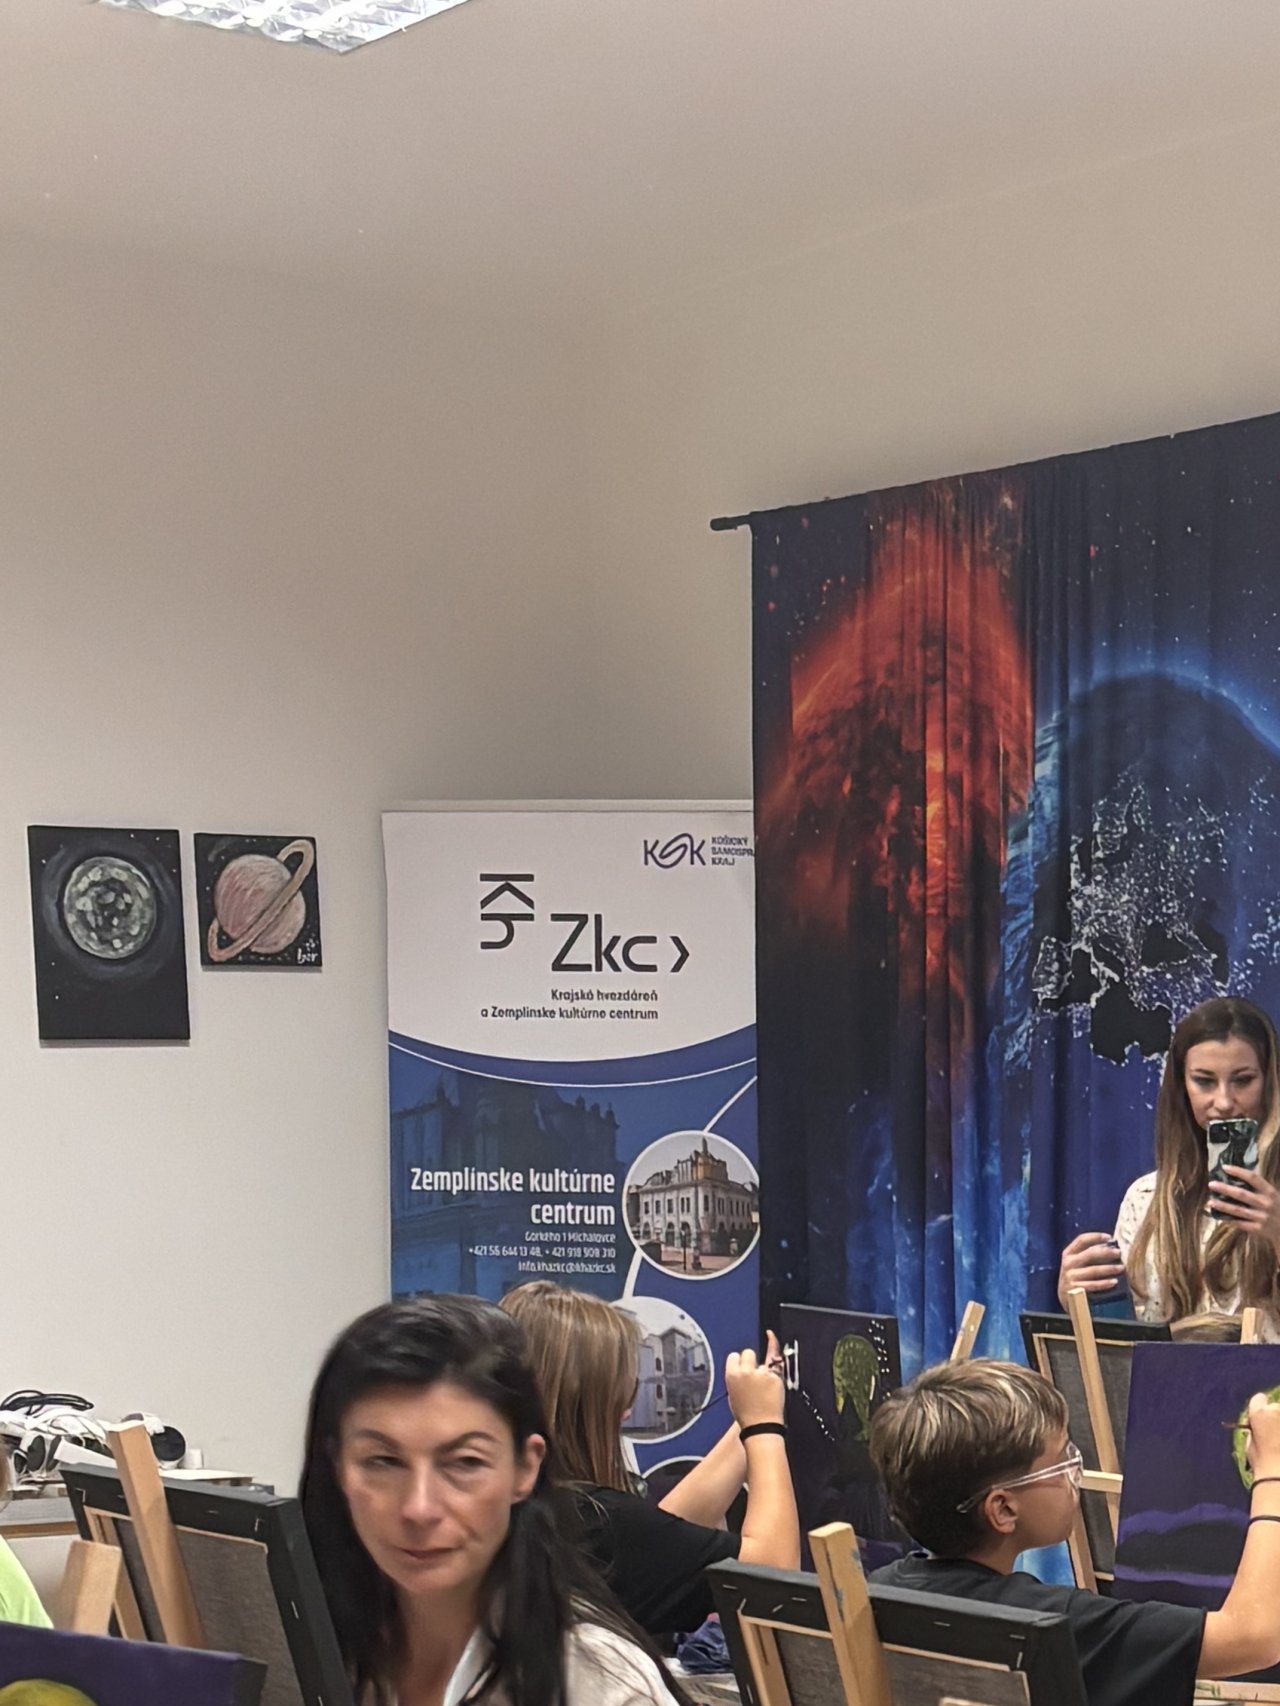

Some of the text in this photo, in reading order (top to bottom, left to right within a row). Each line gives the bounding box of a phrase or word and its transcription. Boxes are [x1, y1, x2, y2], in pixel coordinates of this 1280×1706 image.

[643, 832, 707, 870] KSK
[711, 857, 735, 866] KRAJ
[480, 1008, 488, 1018] a
[559, 1006, 606, 1019] kultúrne
[609, 1008, 659, 1019] centrum
[411, 1166, 615, 1196] Zemplínske kultúrne
[530, 1201, 615, 1225] centrum
[569, 1232, 616, 1244] Michalovce
